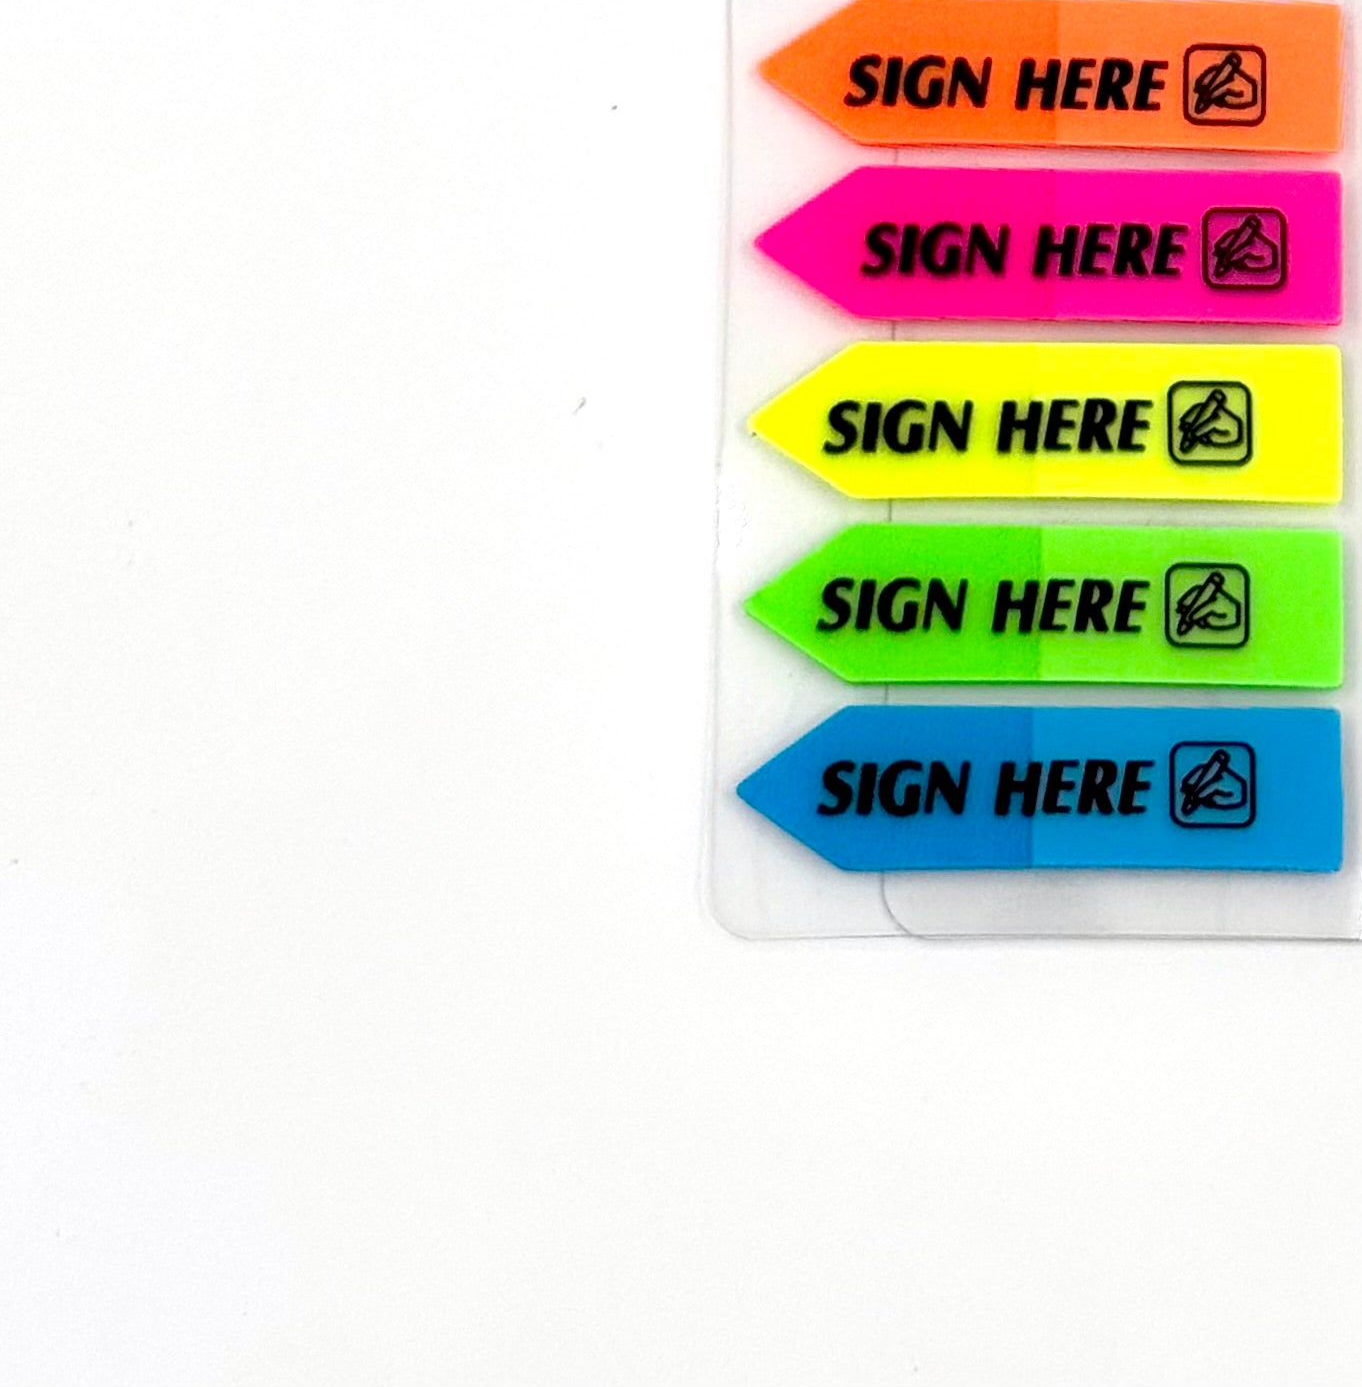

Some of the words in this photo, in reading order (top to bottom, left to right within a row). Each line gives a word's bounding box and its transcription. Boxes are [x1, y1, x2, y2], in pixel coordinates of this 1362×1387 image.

[846, 56, 991, 108] SIGN
[1015, 59, 1168, 111] HERE
[862, 222, 1010, 278] SIGN
[1032, 224, 1187, 279] HERE
[823, 398, 973, 455] SIGN
[996, 398, 1153, 455] HERE
[816, 577, 968, 634] SIGN
[991, 578, 1151, 635] HERE
[816, 759, 972, 819] SIGN
[993, 759, 1155, 819] HERE
